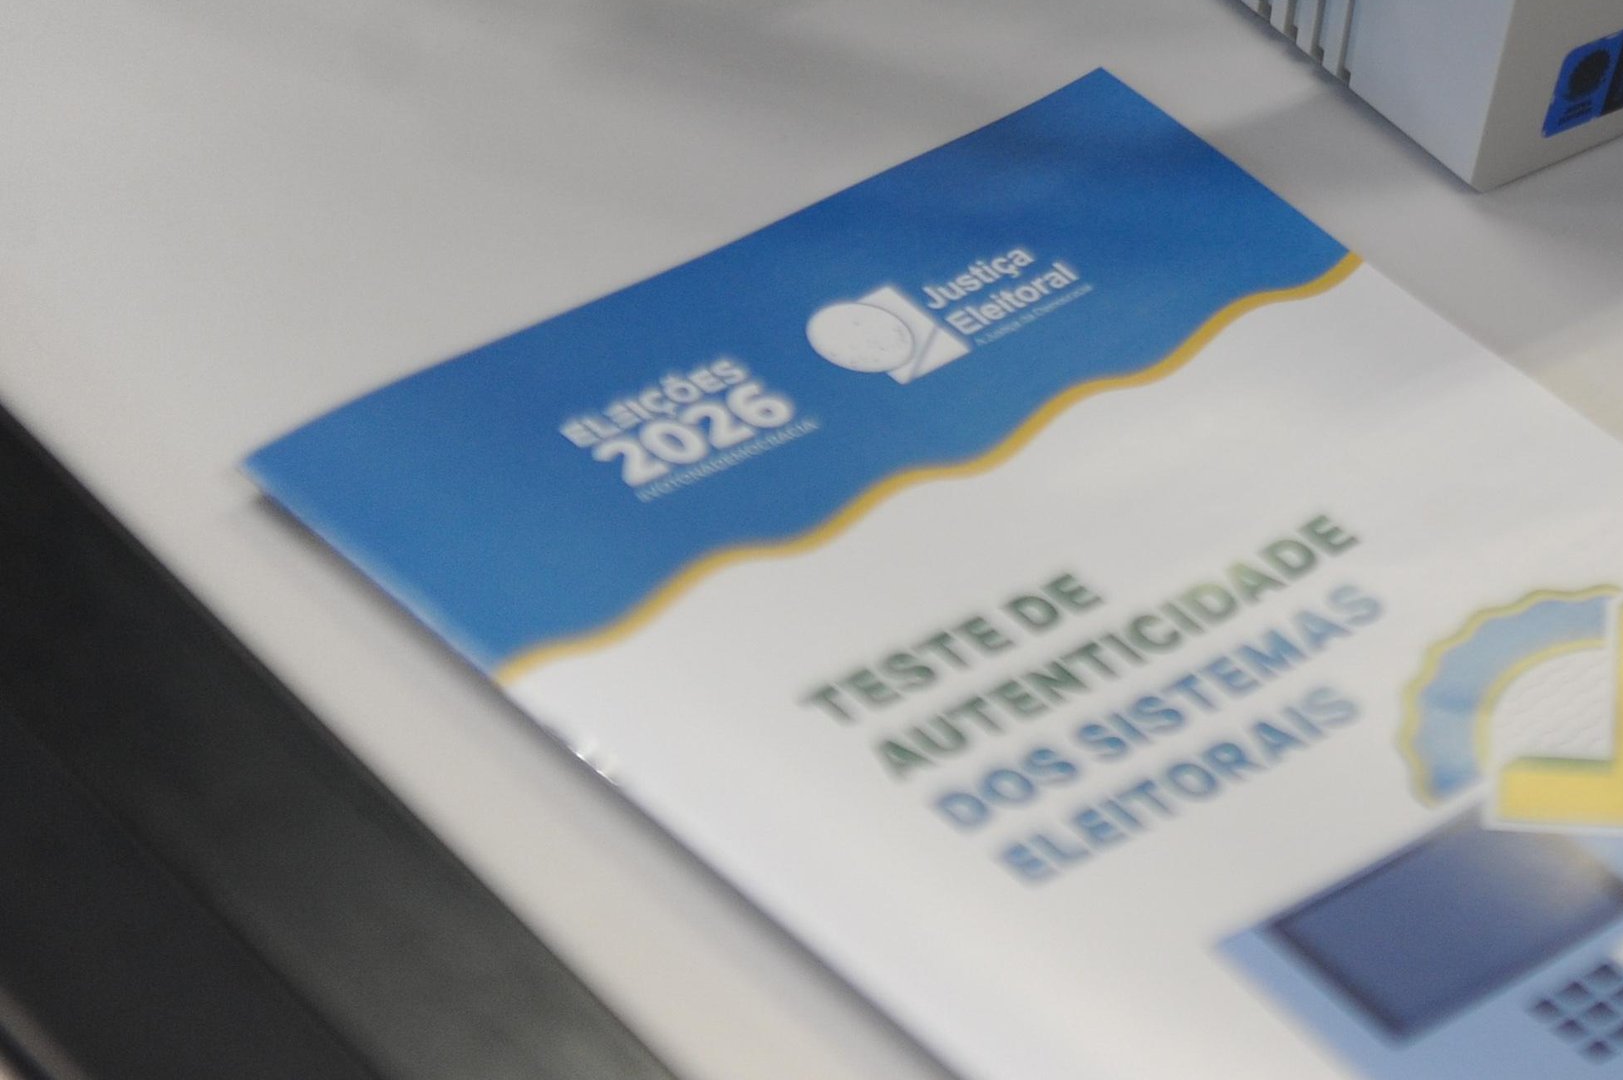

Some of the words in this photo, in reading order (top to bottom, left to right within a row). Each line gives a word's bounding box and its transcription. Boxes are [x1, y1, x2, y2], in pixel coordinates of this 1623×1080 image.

[921, 245, 1035, 311] Justiça
[946, 261, 1079, 335] Eleitoral
[559, 357, 751, 449] ELEIÇÕES
[593, 381, 796, 487] 2026
[802, 617, 1012, 724] TESTE
[1005, 573, 1102, 635] DE
[876, 514, 1359, 777] AUTENTICIDADE
[935, 748, 1080, 831] DOS
[1077, 584, 1384, 761] SISTEMAS
[1000, 686, 1361, 885] ELEITORAIS
